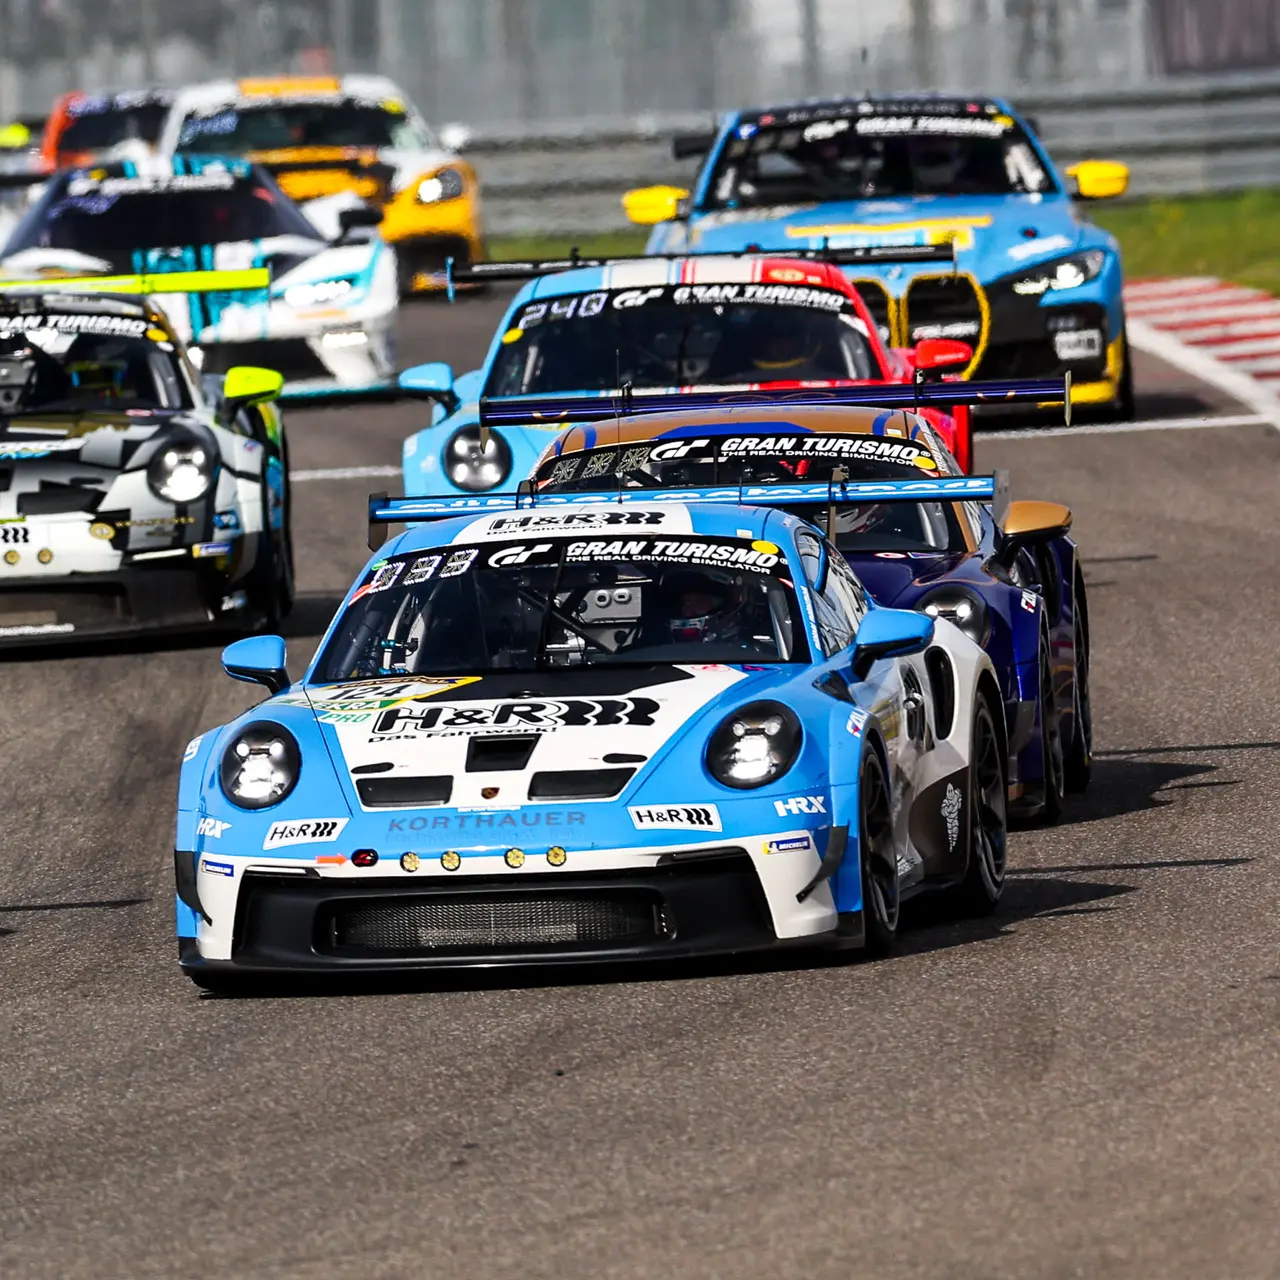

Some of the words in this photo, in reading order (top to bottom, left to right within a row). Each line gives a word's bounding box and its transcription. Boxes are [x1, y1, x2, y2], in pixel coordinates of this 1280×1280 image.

[674, 285, 740, 299] GRAN
[745, 286, 843, 306] TURISMO
[45, 316, 146, 336] TURISMO
[721, 438, 798, 451] GRAN
[802, 439, 920, 459] TURISMO
[783, 451, 838, 459] DRIVING
[842, 453, 914, 466] SIMULATOR
[567, 541, 647, 556] GRAN
[661, 543, 779, 566] TURISMO
[629, 556, 689, 567] DRIVING
[692, 559, 770, 574] SIMULATOR
[337, 684, 404, 700] 124
[368, 734, 419, 743] Das
[427, 727, 557, 739] Fahrwerk!
[774, 796, 826, 816] HRX
[197, 819, 232, 838] HRX
[389, 811, 585, 831] KORTHAUER
[779, 840, 808, 850] MICHELIN
